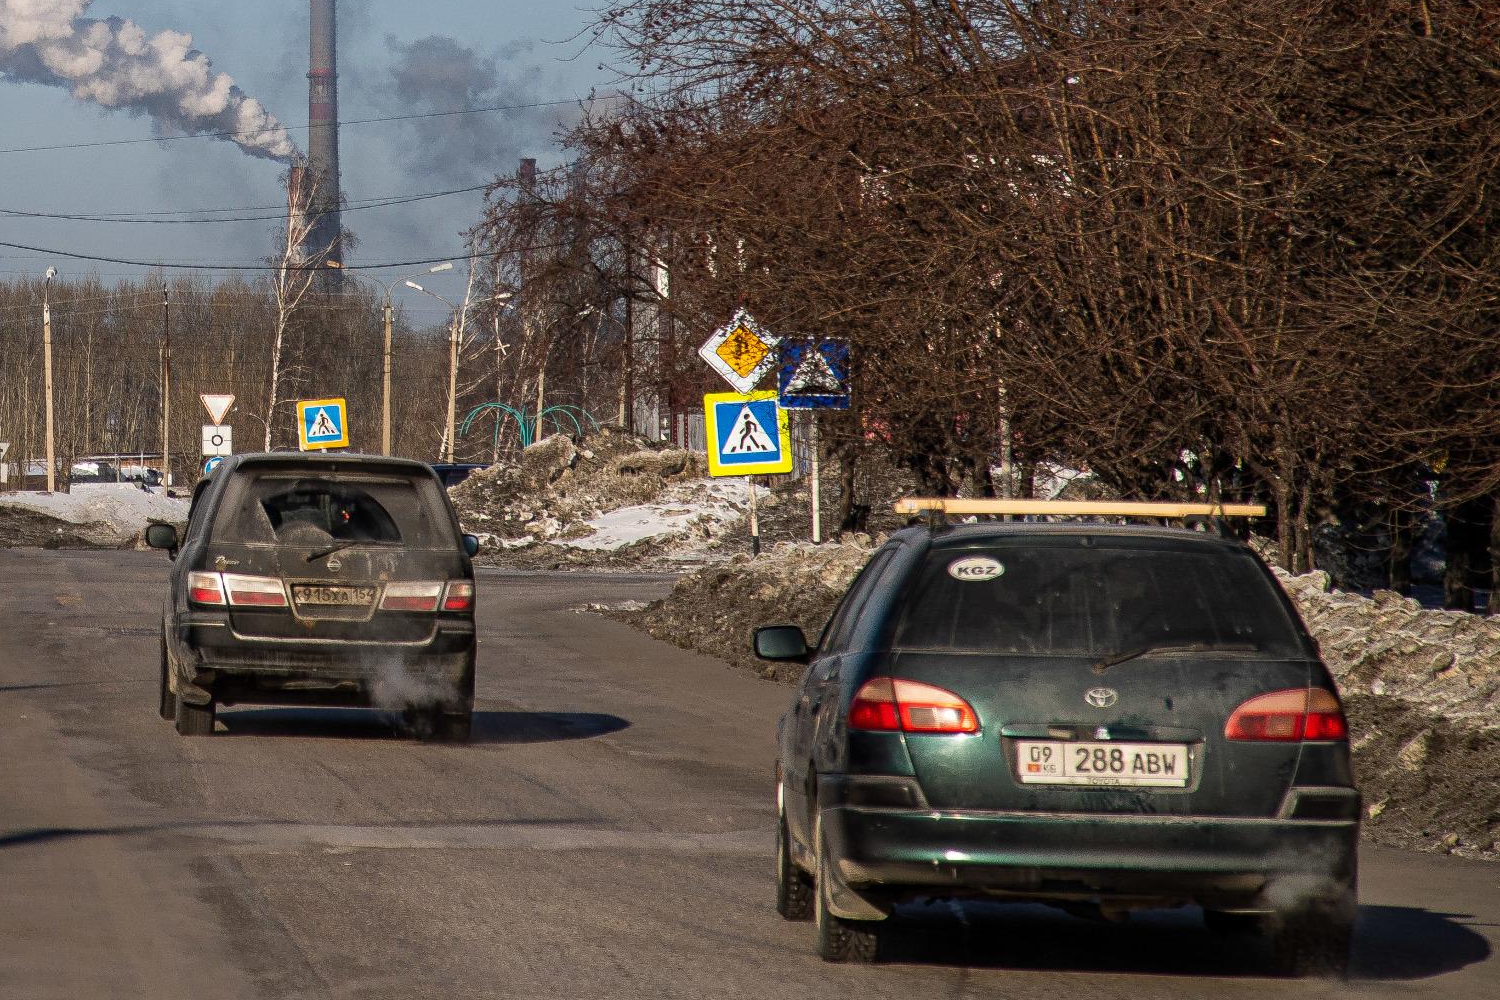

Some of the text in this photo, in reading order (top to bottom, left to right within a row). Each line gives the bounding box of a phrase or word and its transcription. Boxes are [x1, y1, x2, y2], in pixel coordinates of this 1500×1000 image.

[958, 566, 997, 576] KGZ
[1030, 746, 1177, 775] 09 288 ABW
[1087, 775, 1121, 785] TOYOTA
